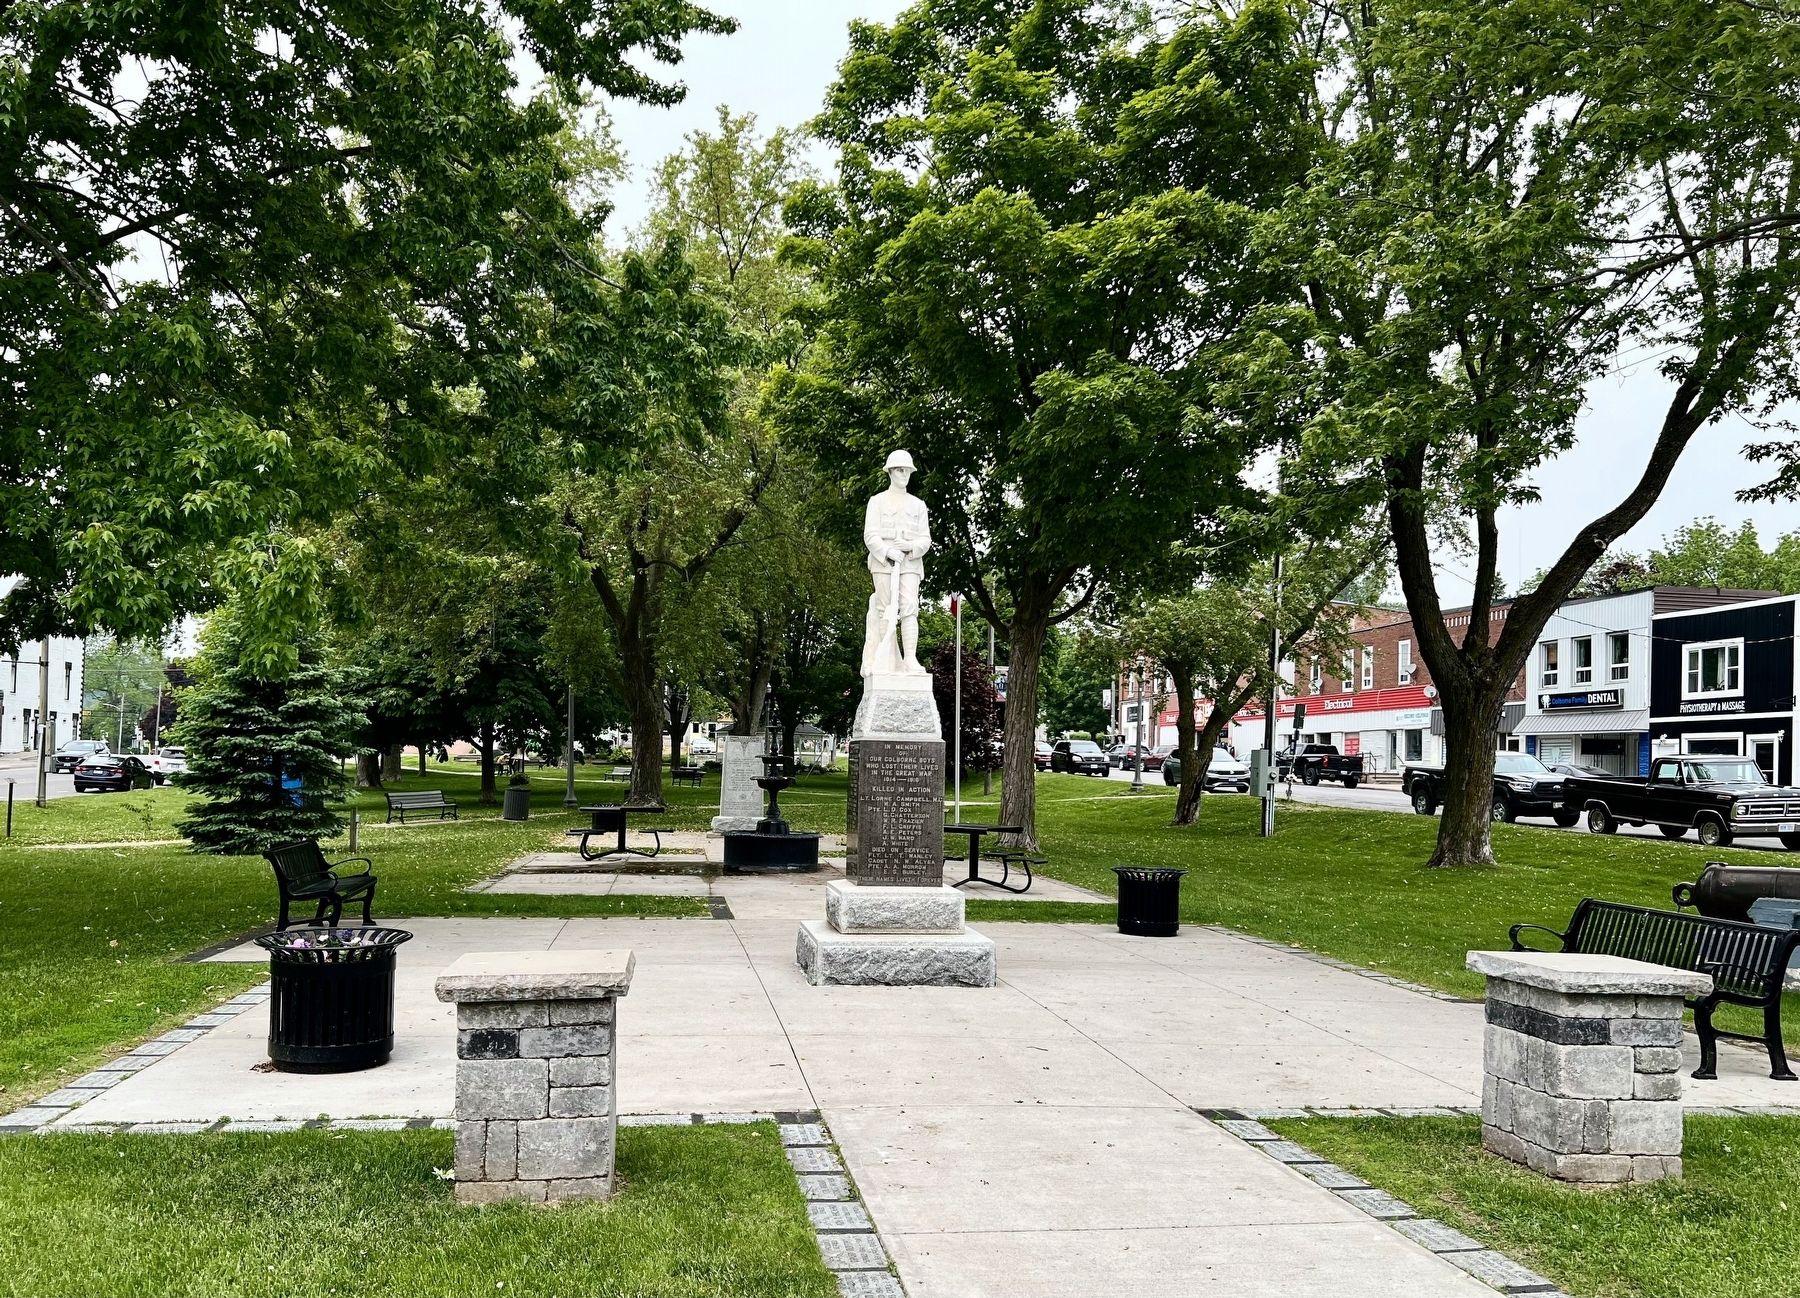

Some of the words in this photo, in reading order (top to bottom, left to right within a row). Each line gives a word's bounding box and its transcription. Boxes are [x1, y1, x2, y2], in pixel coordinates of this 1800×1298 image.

[1324, 698, 1352, 709] Electrical
[1588, 692, 1616, 704] DENTAL
[1680, 702, 1717, 713] PHYSIOTHERAPY
[1722, 701, 1745, 711] MASSAGE
